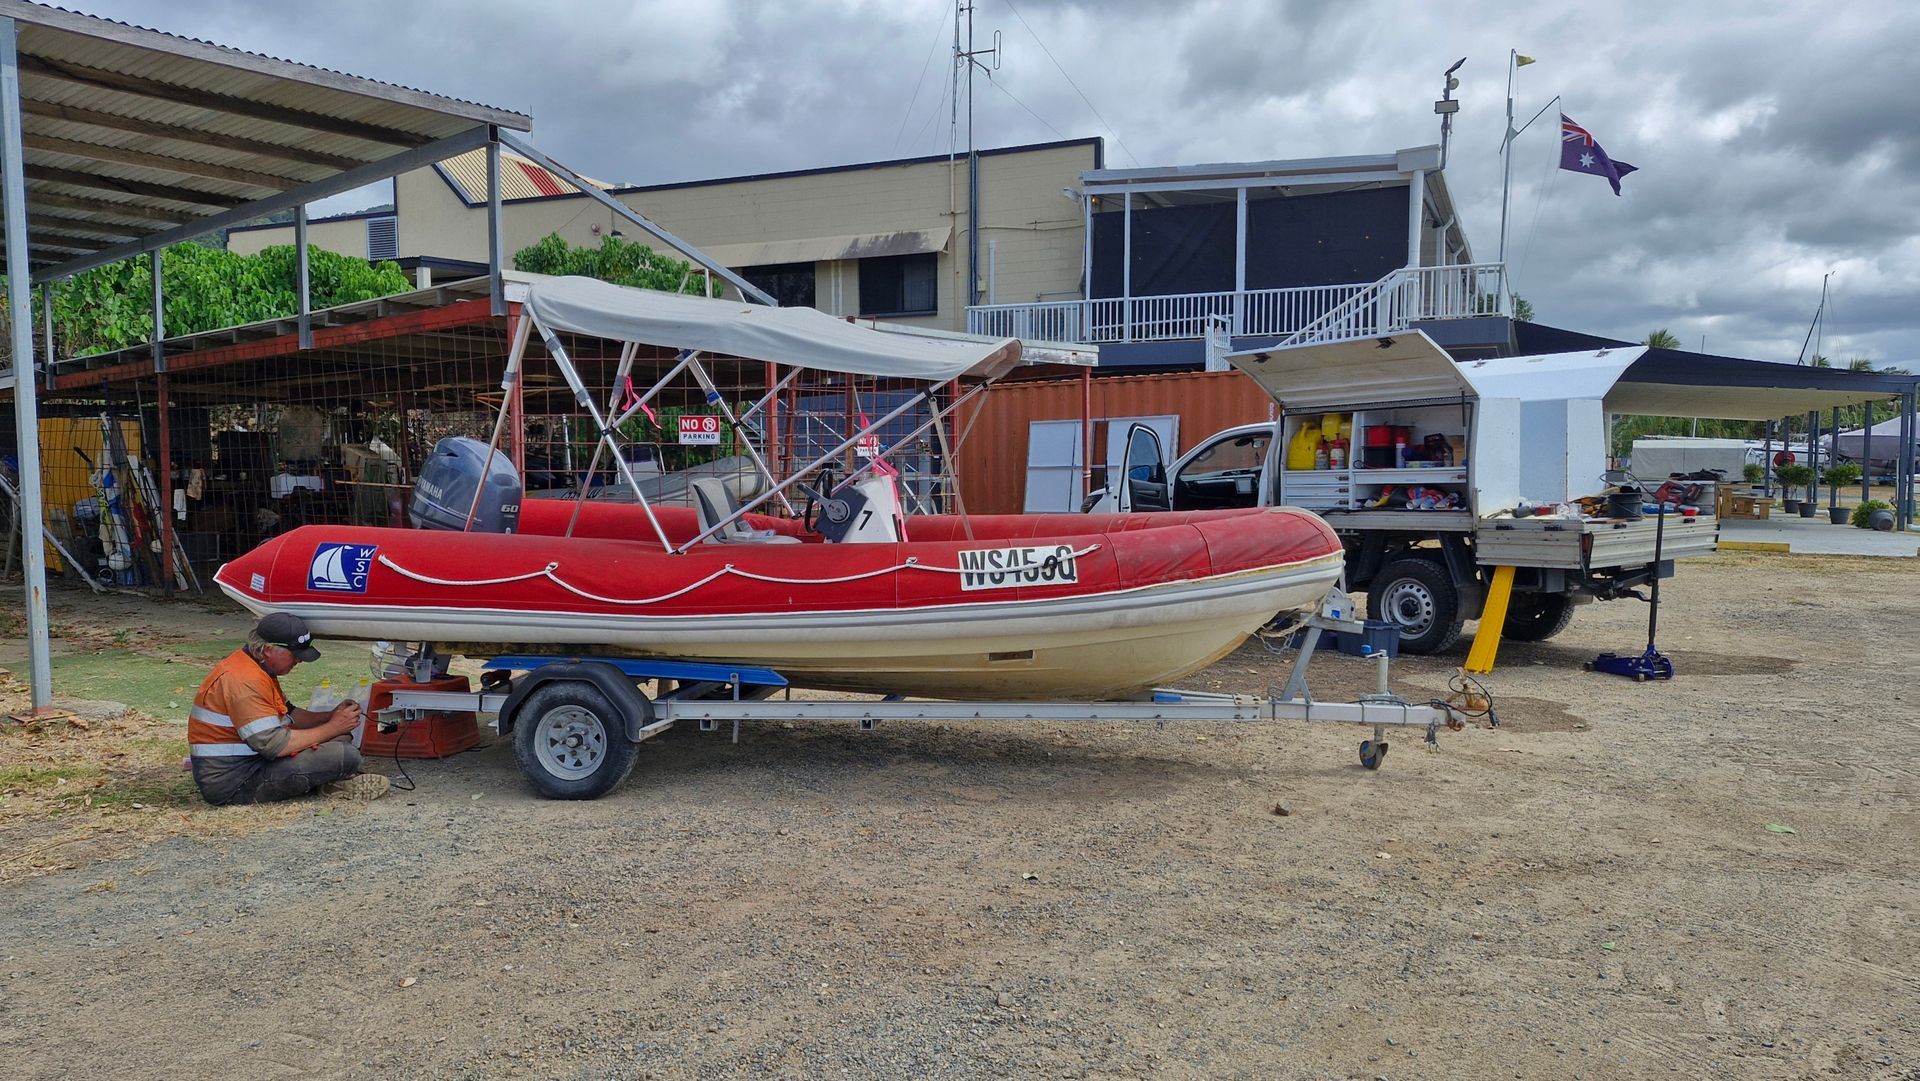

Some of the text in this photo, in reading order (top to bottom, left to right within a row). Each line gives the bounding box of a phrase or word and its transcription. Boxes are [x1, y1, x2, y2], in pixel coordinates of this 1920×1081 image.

[681, 419, 698, 430] NO
[420, 478, 443, 500] YAMAHA
[501, 504, 518, 513] 60
[858, 510, 873, 531] 7
